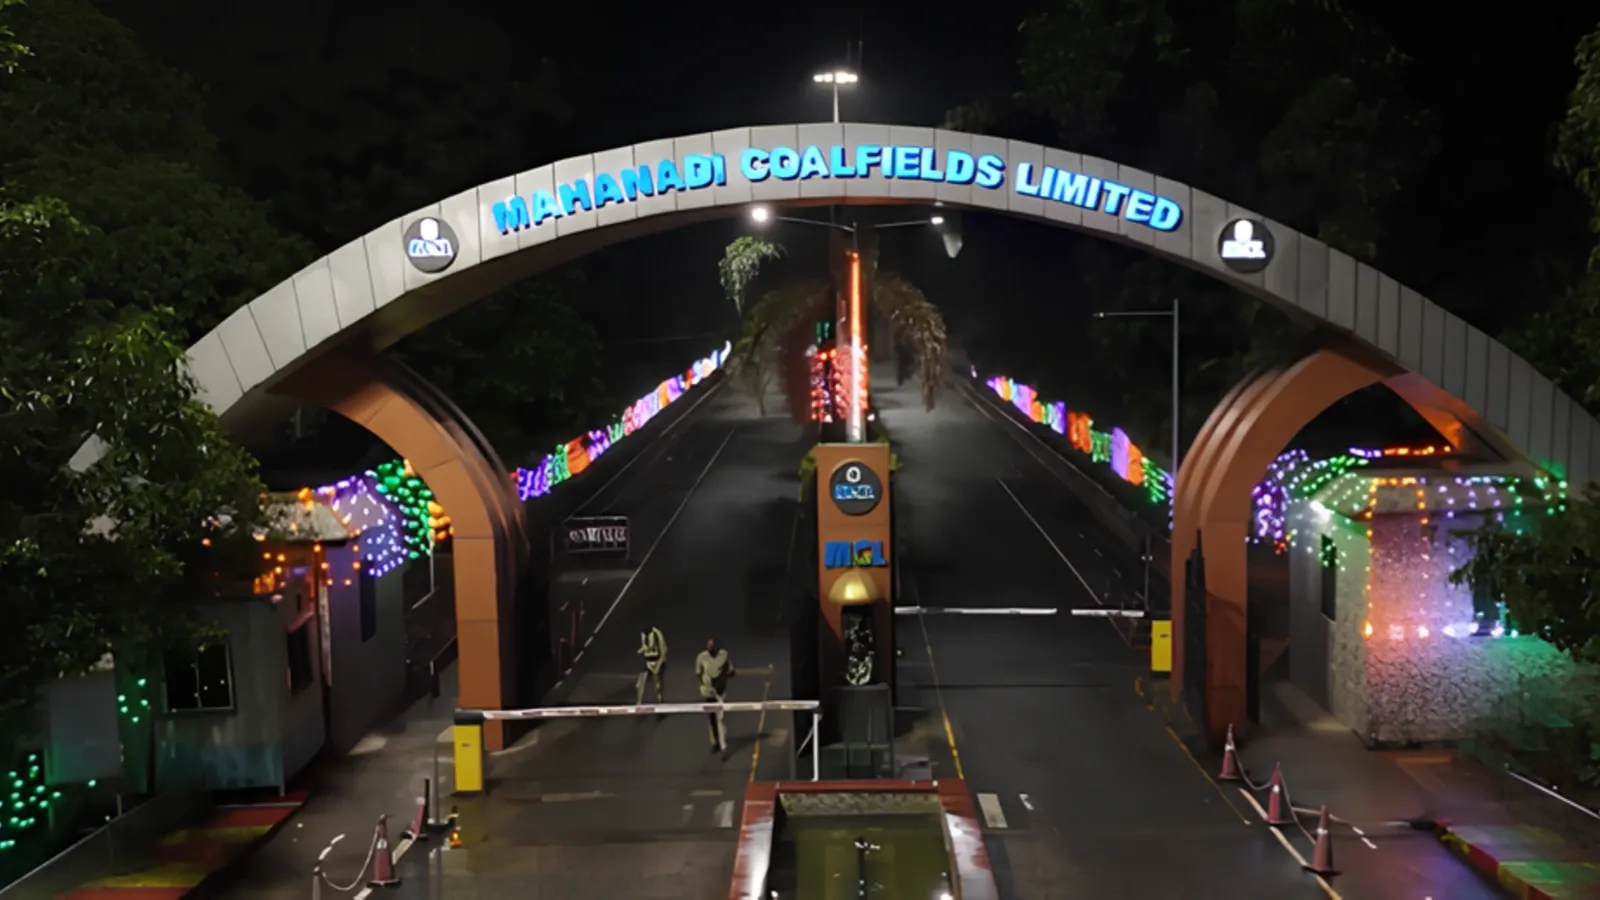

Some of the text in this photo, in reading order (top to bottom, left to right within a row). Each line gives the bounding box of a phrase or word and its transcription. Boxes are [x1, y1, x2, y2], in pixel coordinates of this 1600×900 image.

[491, 145, 1183, 234] MAHANADI COALFIELDS LIMITED
